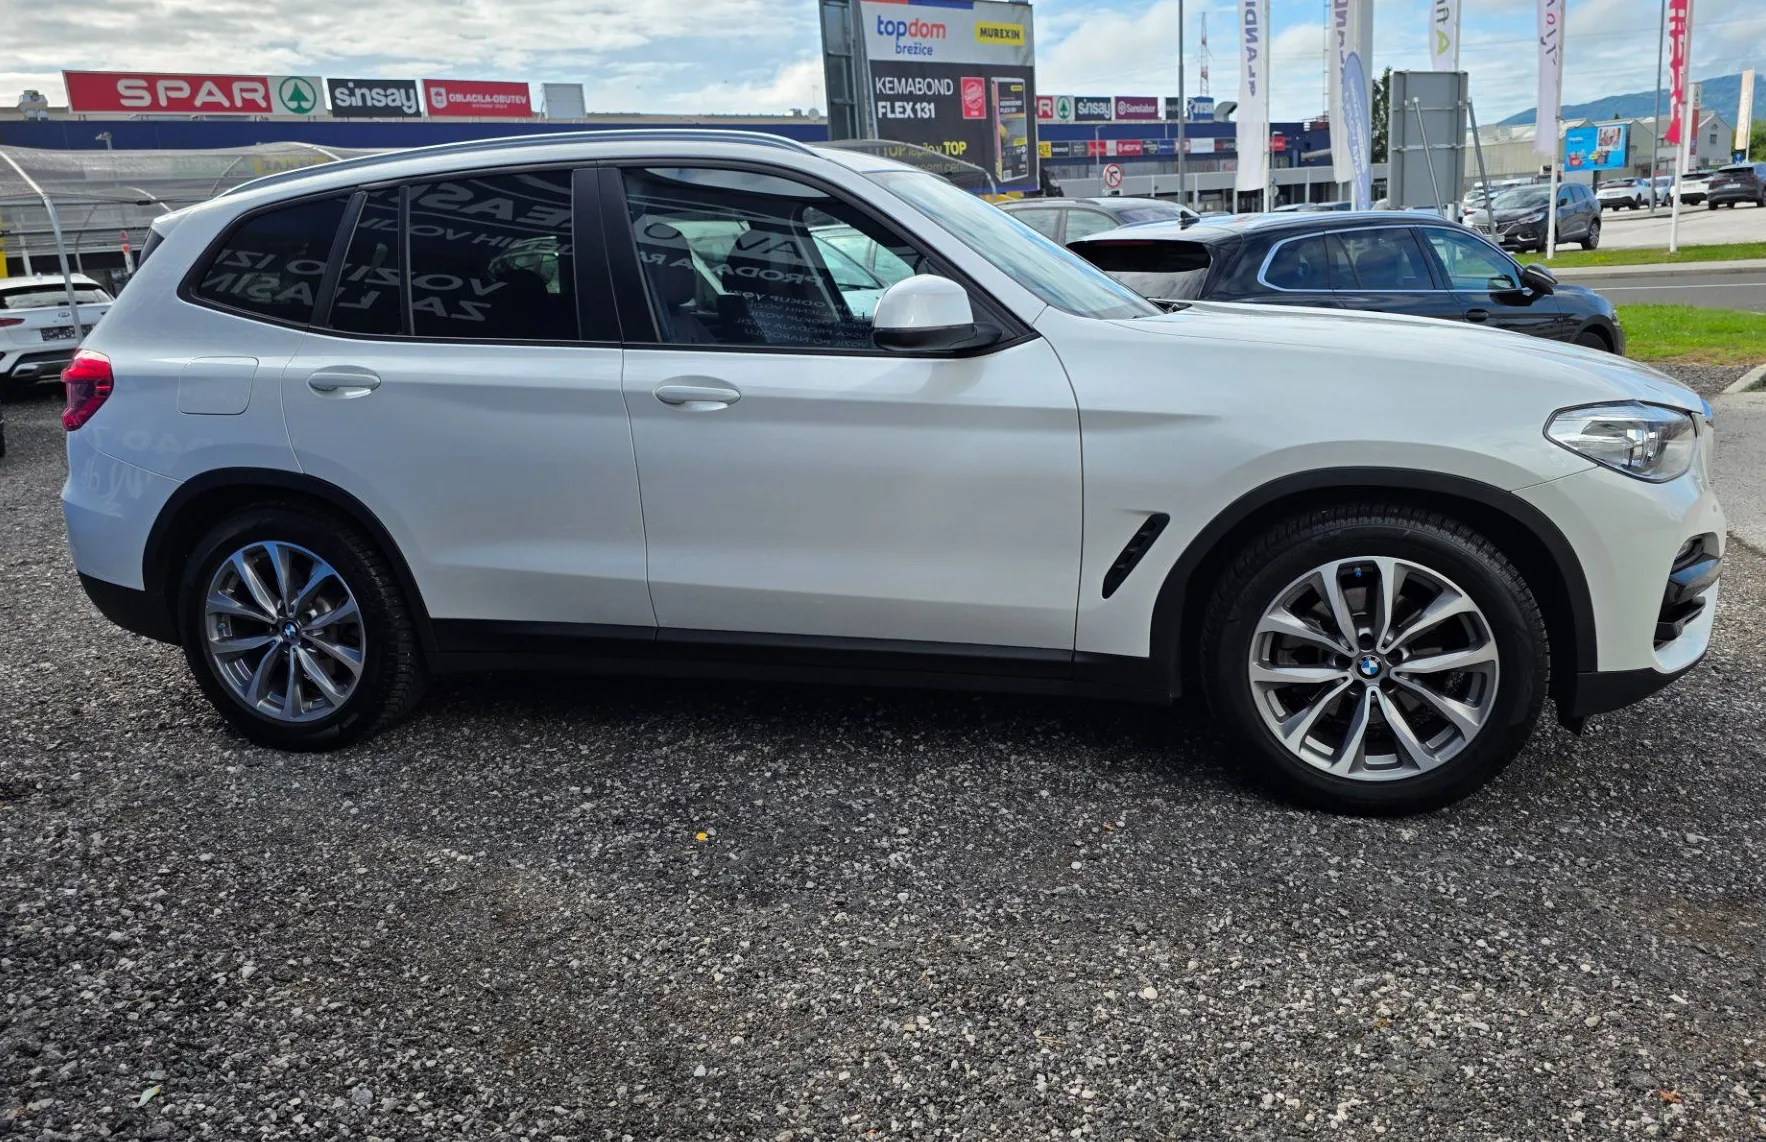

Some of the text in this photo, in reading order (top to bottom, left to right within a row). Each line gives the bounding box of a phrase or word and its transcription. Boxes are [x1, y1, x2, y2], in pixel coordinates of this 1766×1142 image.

[877, 15, 946, 41] topdom
[979, 27, 1021, 40] MUREXIN
[895, 42, 933, 55] brežice
[116, 78, 268, 108] SPAR
[875, 77, 954, 95] KEMABOND
[334, 82, 416, 114] sinsay
[877, 101, 935, 118] FLEX 131
[1077, 98, 1111, 119] sinsay
[943, 141, 967, 156] TOP
